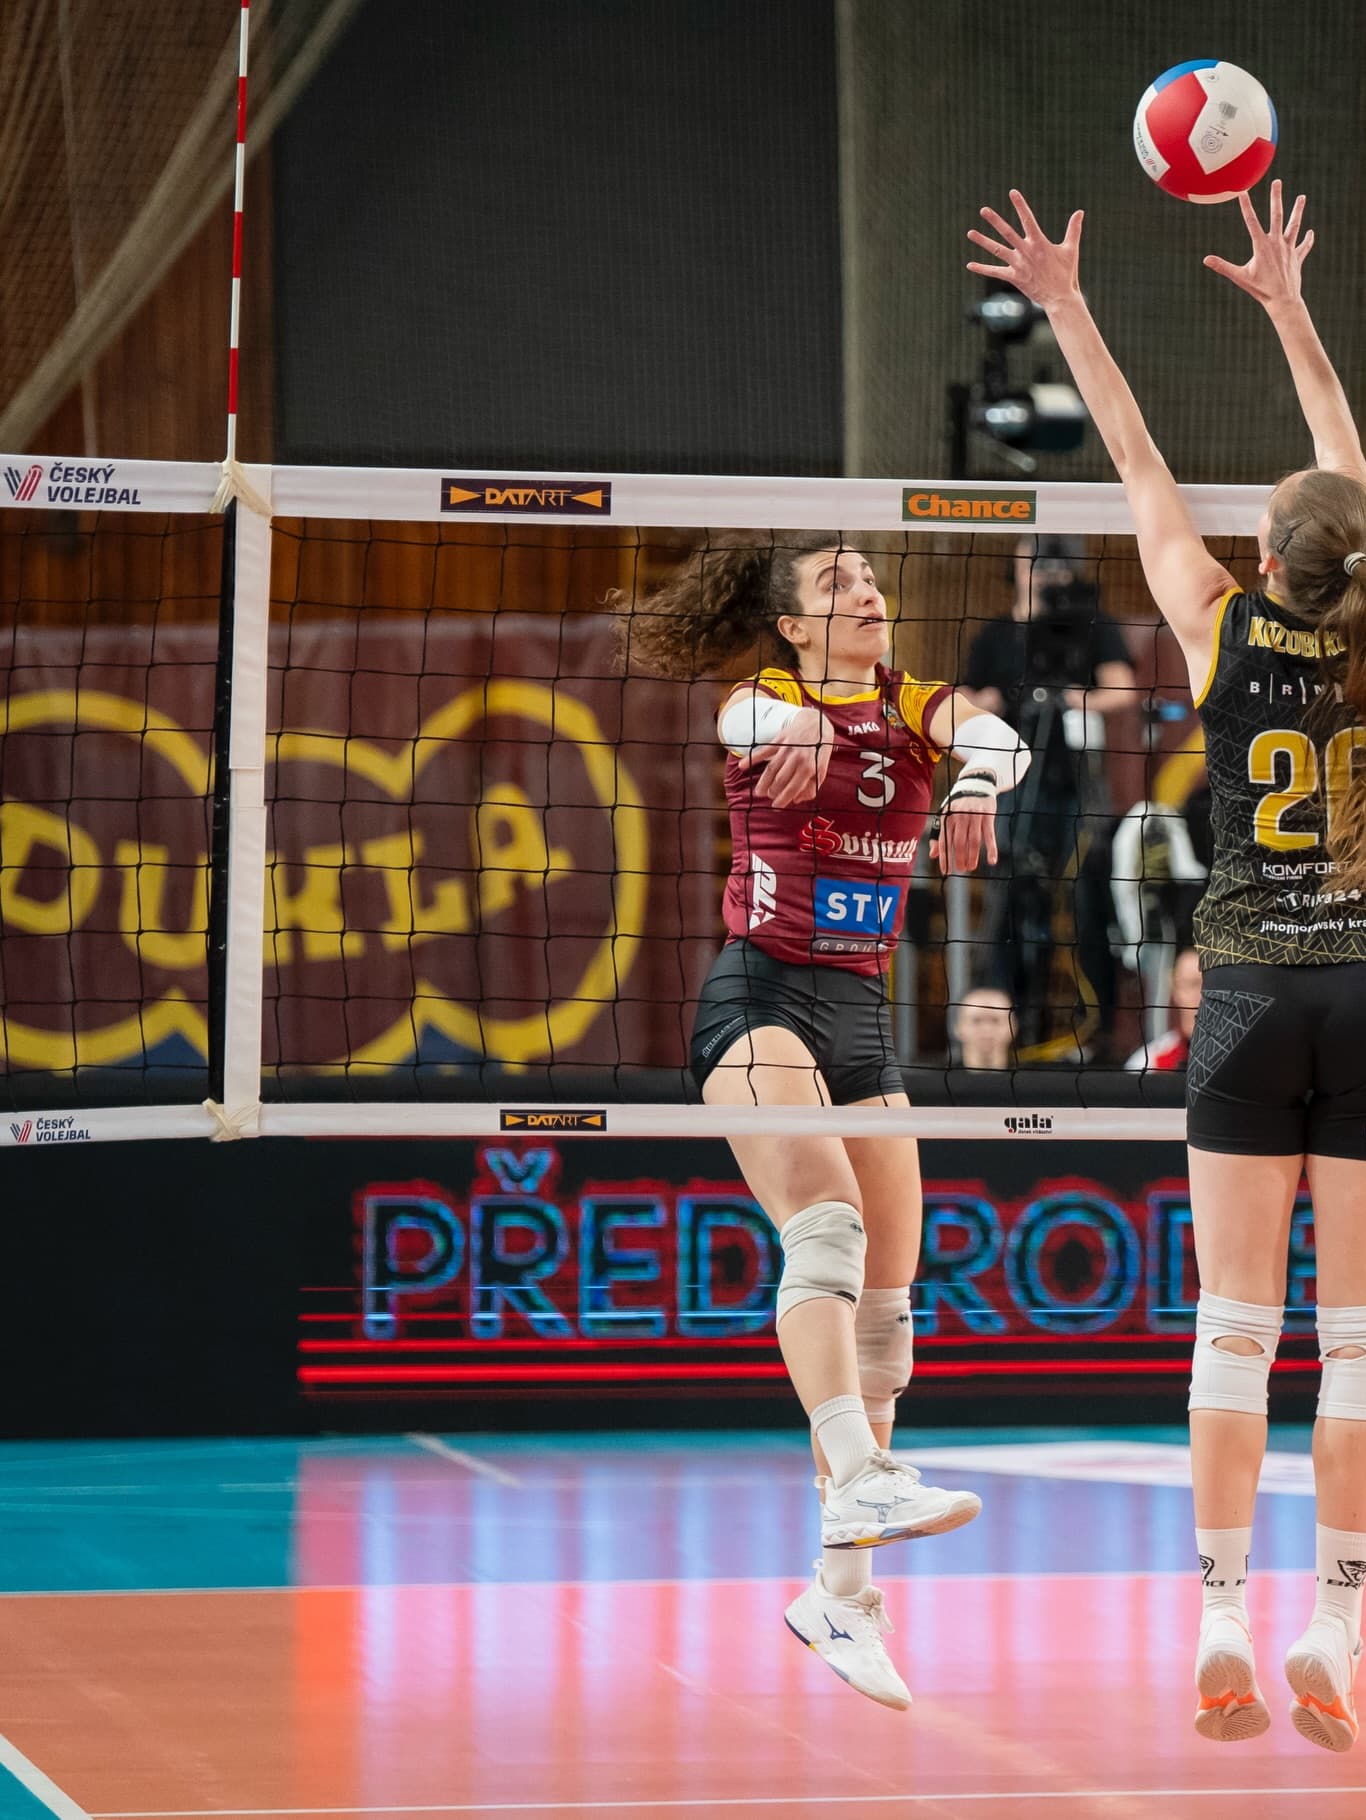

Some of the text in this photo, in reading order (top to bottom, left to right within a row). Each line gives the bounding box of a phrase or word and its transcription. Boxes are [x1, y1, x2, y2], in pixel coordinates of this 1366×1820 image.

[49, 462, 115, 483] ČESKÝ
[47, 486, 141, 505] VOLEJBAL
[485, 487, 572, 506] DATART
[908, 493, 1030, 518] Chance
[848, 721, 880, 736] JAKO
[858, 751, 896, 808] 3
[36, 1116, 75, 1130] ČESKÝ
[527, 1114, 581, 1126] DATART
[36, 1129, 91, 1142] VOLEJBAL
